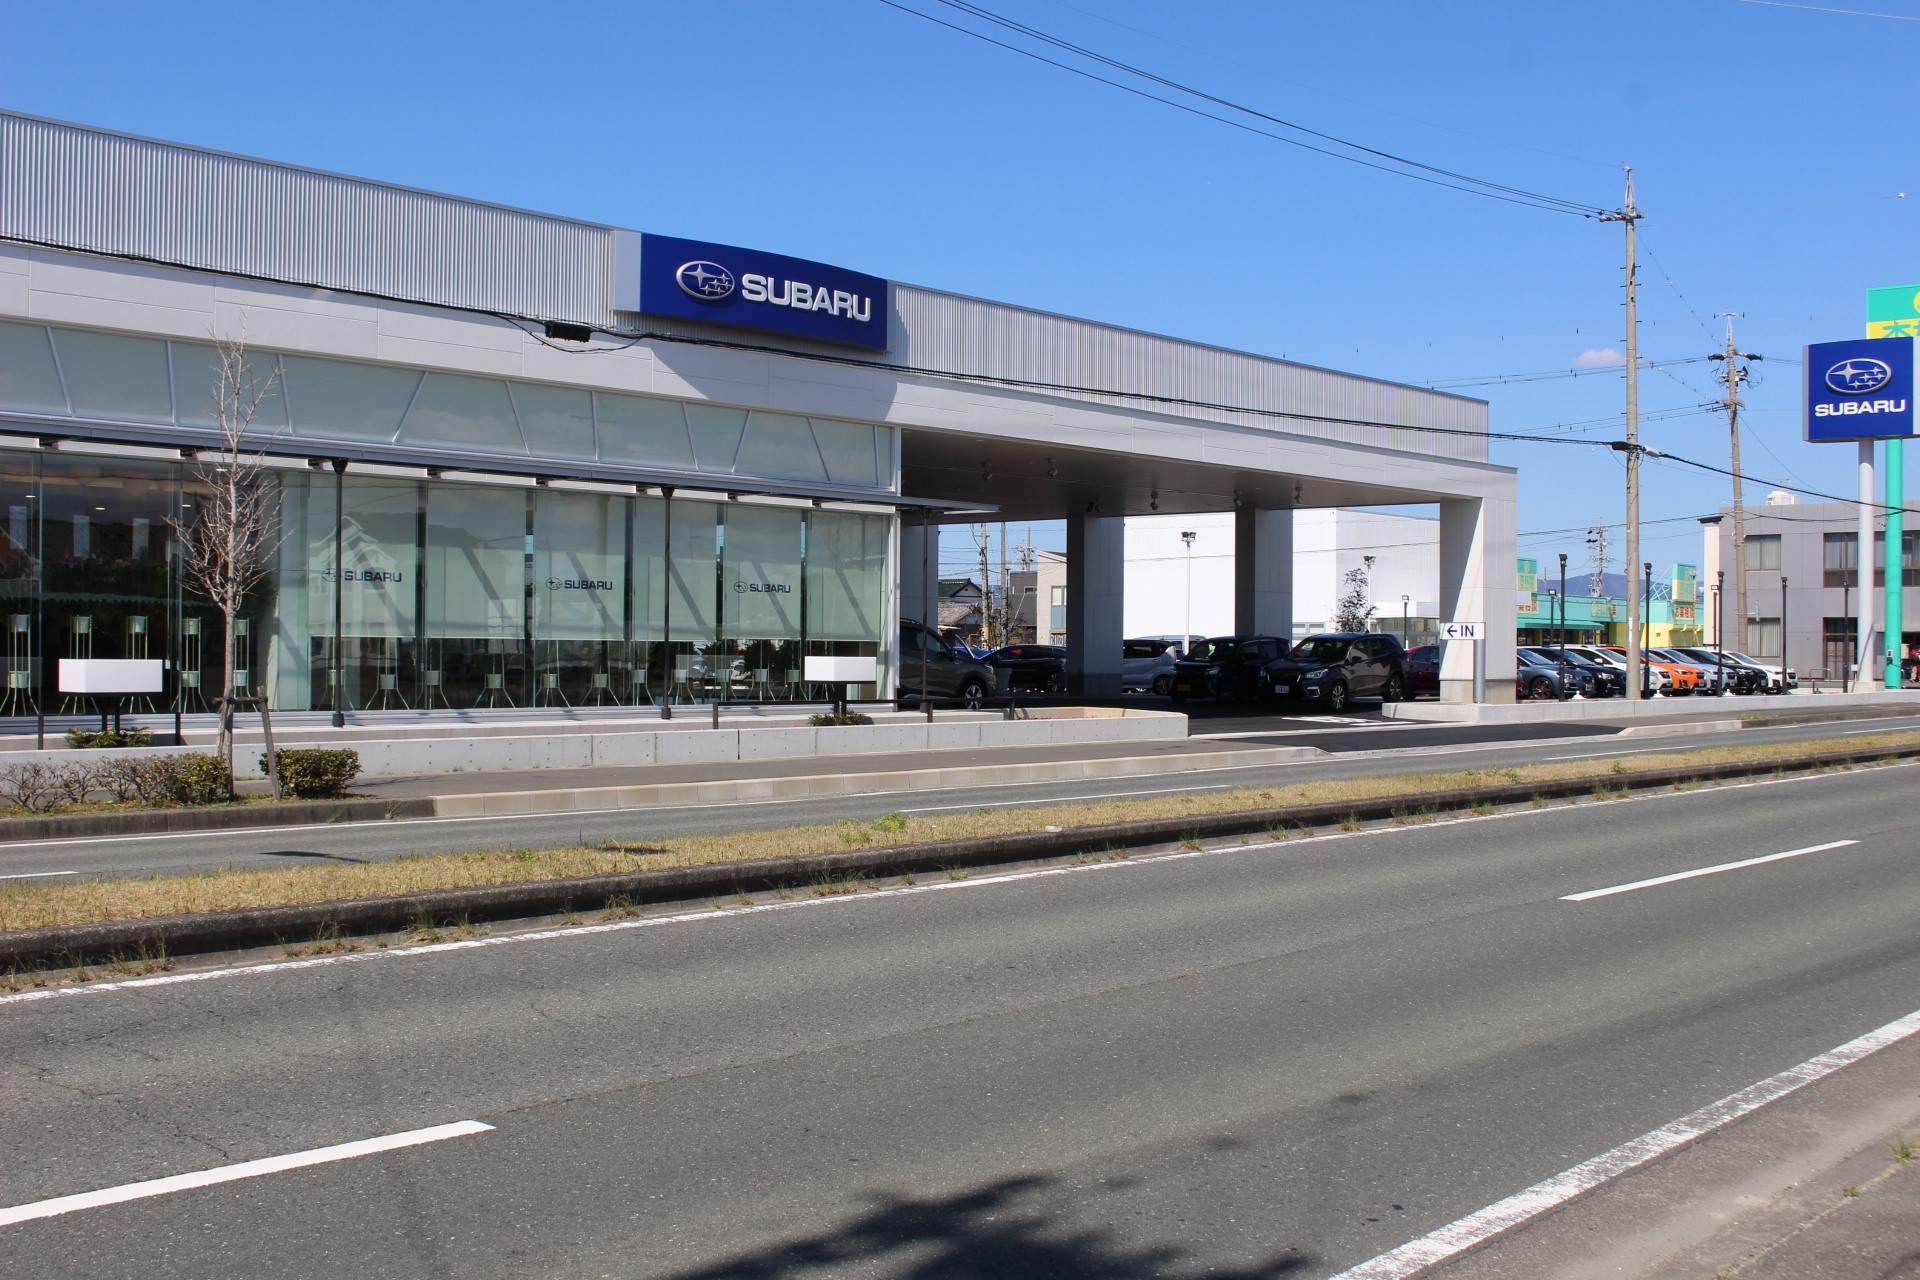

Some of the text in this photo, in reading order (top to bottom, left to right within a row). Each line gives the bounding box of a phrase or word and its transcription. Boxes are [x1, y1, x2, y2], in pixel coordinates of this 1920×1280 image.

[742, 273, 870, 322] SUBARU
[1815, 399, 1905, 417] SUBARU
[345, 571, 402, 583] SUBARU
[564, 579, 612, 590] SUBARU
[749, 583, 791, 593] SUBARU
[1461, 625, 1474, 637] IN
